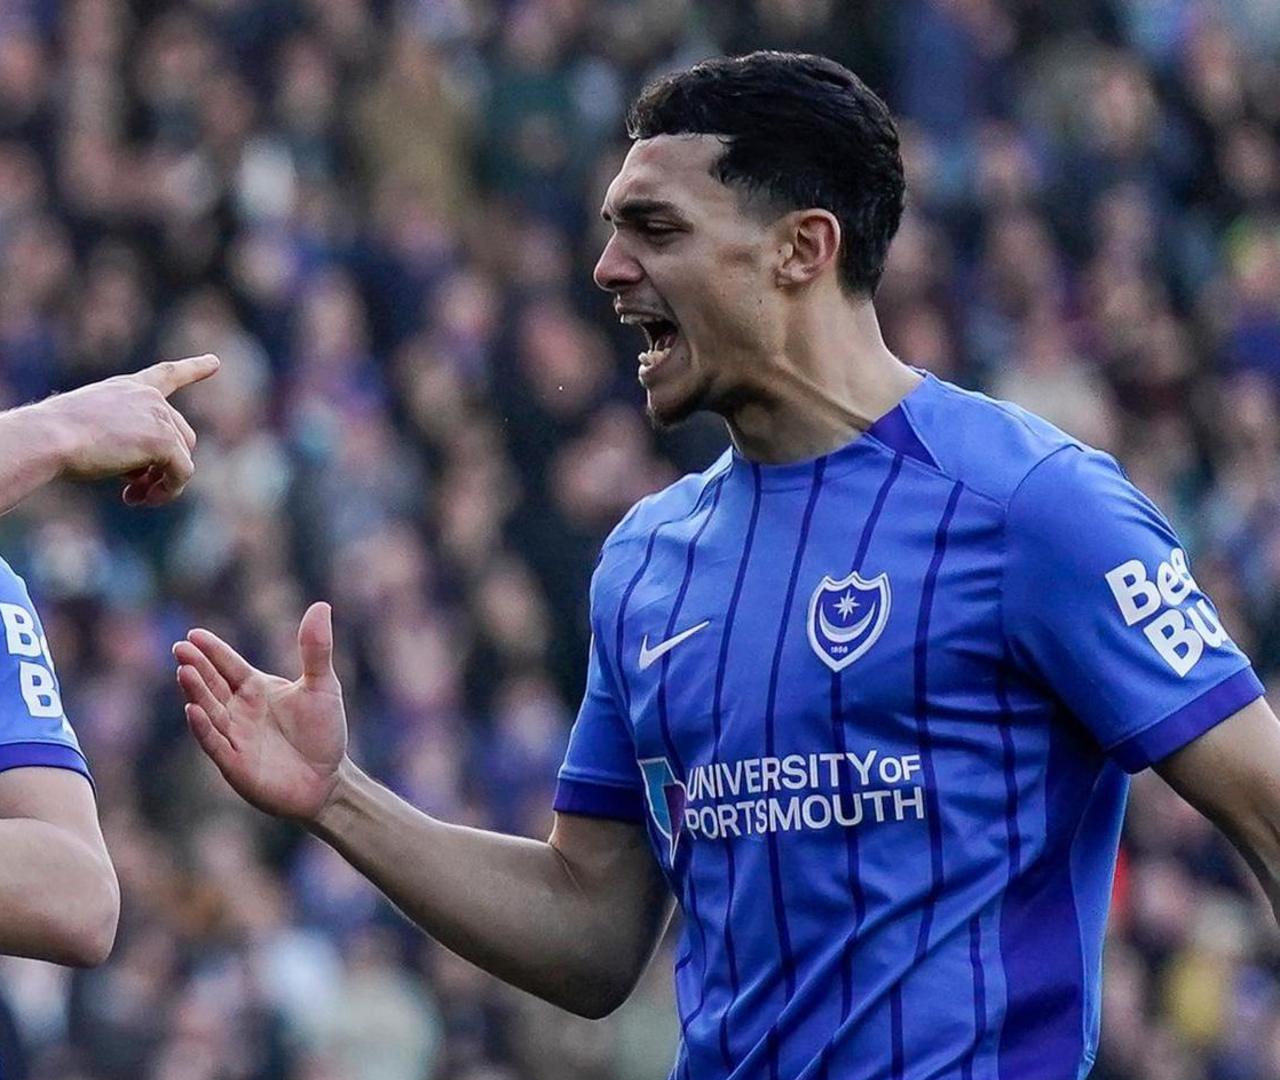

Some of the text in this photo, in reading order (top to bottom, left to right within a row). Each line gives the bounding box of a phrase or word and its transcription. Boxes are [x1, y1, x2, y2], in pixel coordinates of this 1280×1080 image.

[1142, 599, 1229, 678] Bu
[19, 660, 64, 719] B
[687, 750, 921, 802] UNIVERSITY OF
[685, 786, 925, 840] PORTSMOUTH
